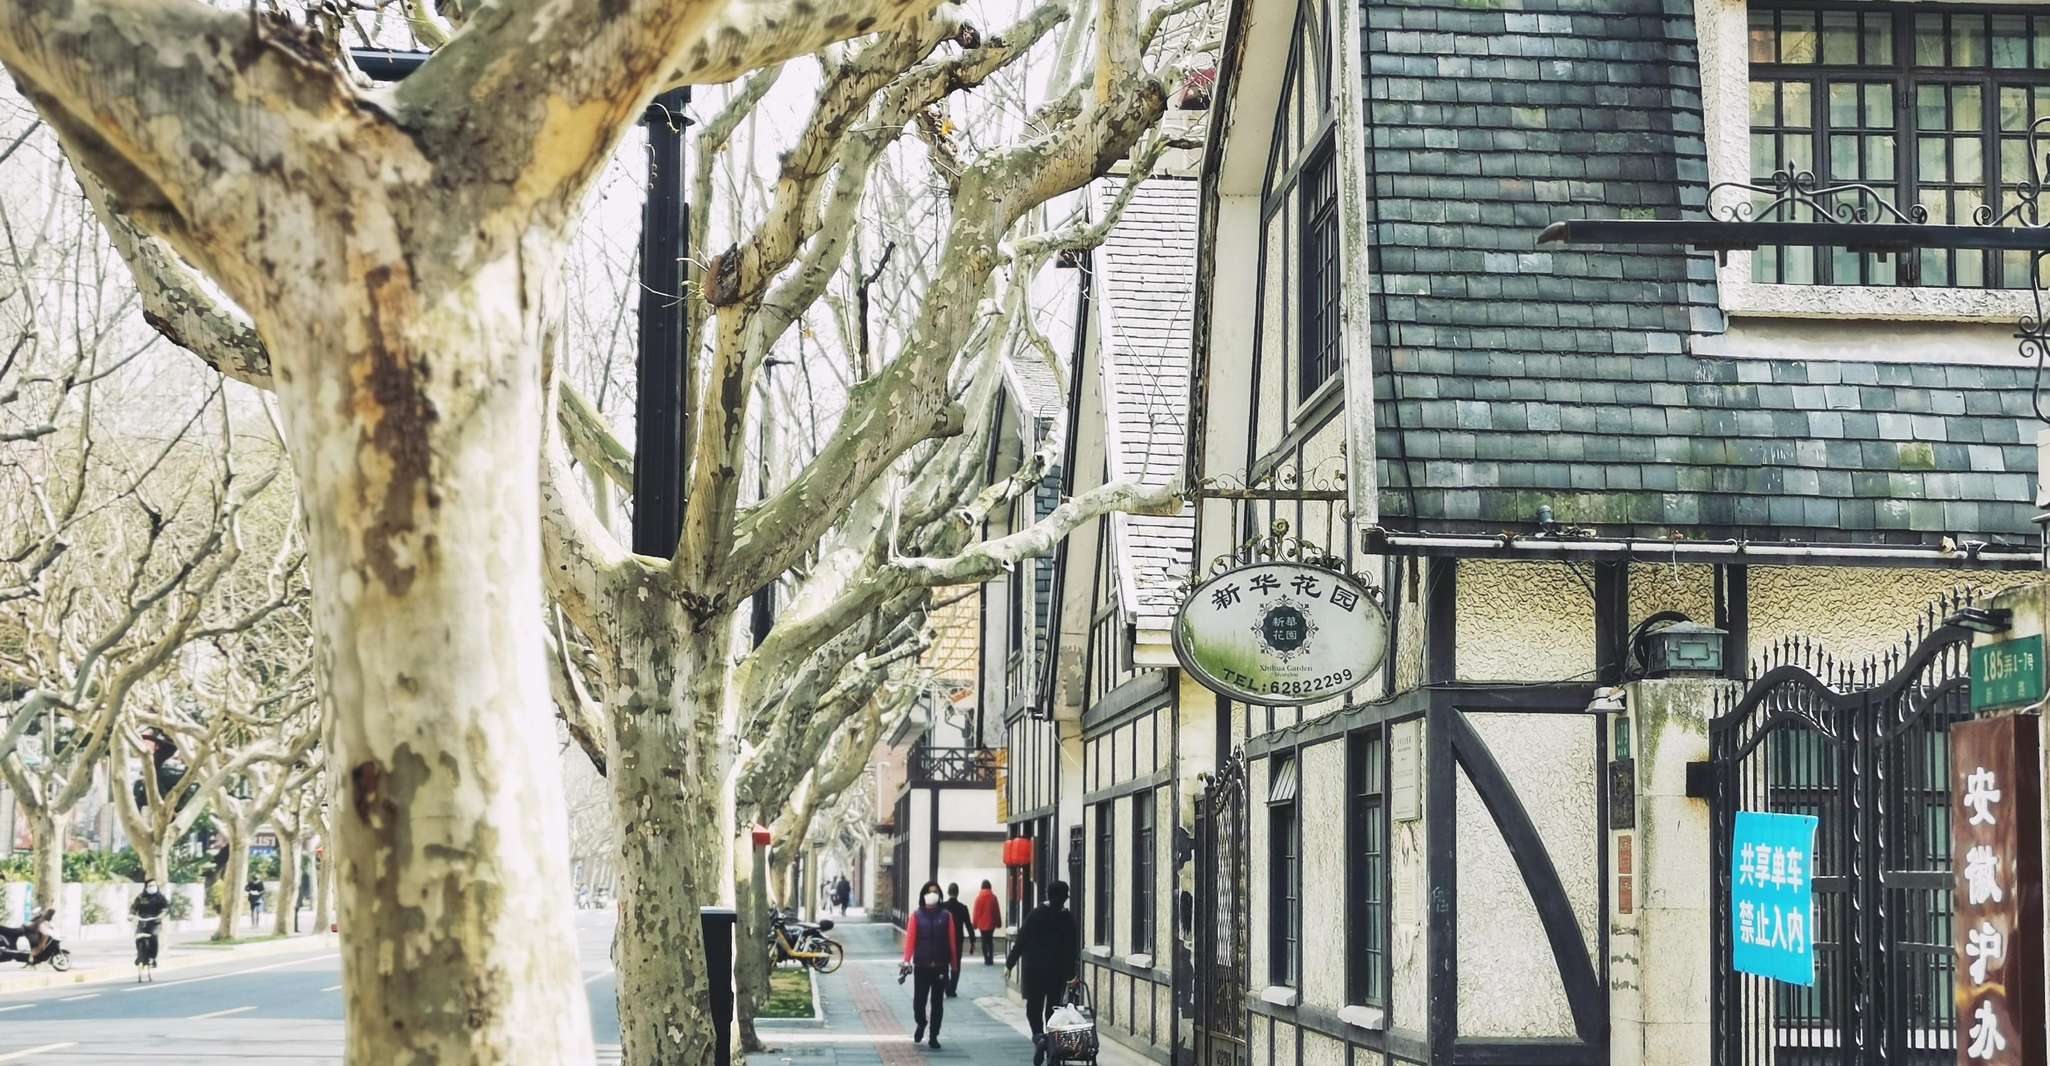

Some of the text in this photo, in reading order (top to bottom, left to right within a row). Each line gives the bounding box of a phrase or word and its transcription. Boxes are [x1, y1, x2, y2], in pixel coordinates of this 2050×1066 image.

[1211, 573, 1360, 612] 新华花园
[1223, 668, 1353, 694] TEL:62822299
[1287, 664, 1313, 672] Garden
[1739, 842, 1804, 894] 共享单车
[1739, 899, 1805, 954] 禁止入内
[1963, 766, 2006, 1060] 安徽沪办
